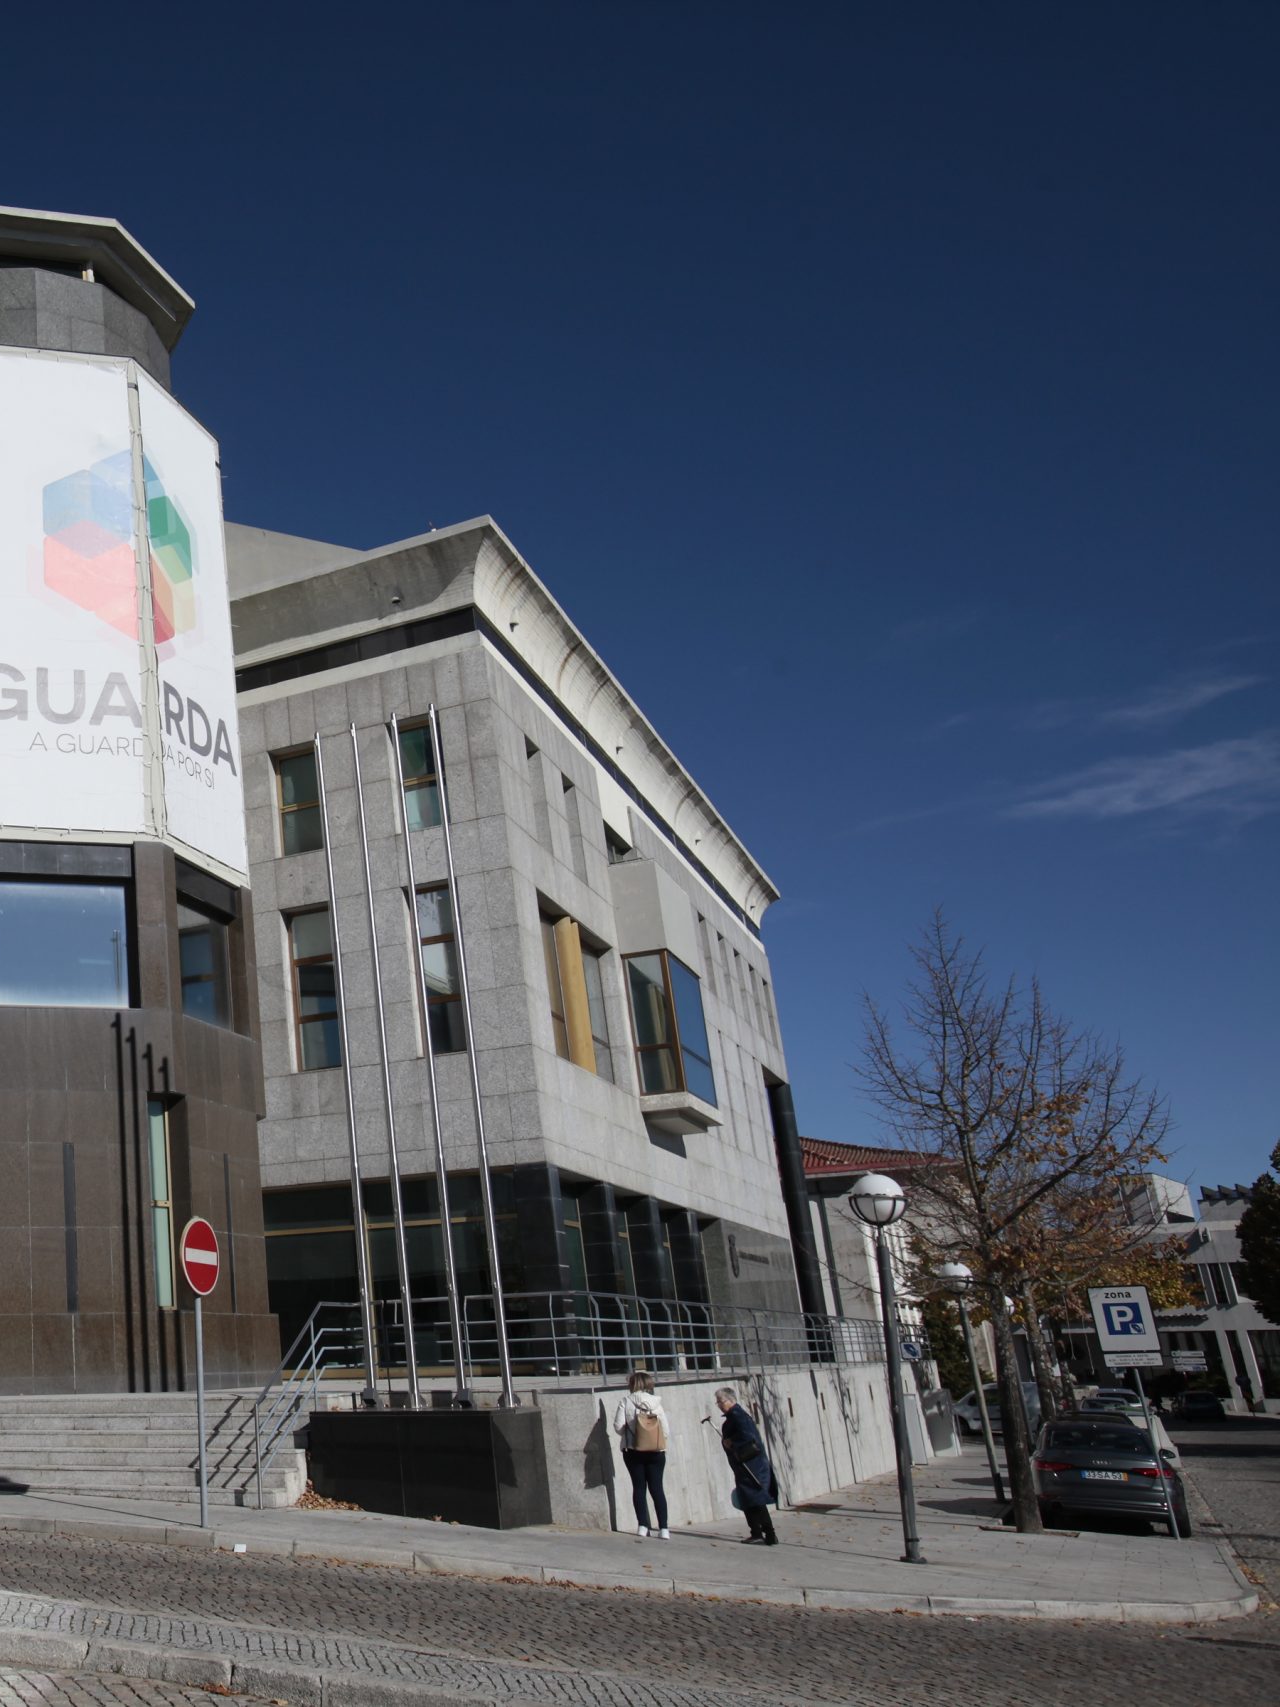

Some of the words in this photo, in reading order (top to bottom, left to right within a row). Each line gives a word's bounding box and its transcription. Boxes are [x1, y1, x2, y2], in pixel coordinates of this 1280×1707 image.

[29, 732, 48, 751] A
[177, 751, 202, 782] POR
[1104, 1291, 1132, 1299] zona
[1110, 1305, 1134, 1331] P
